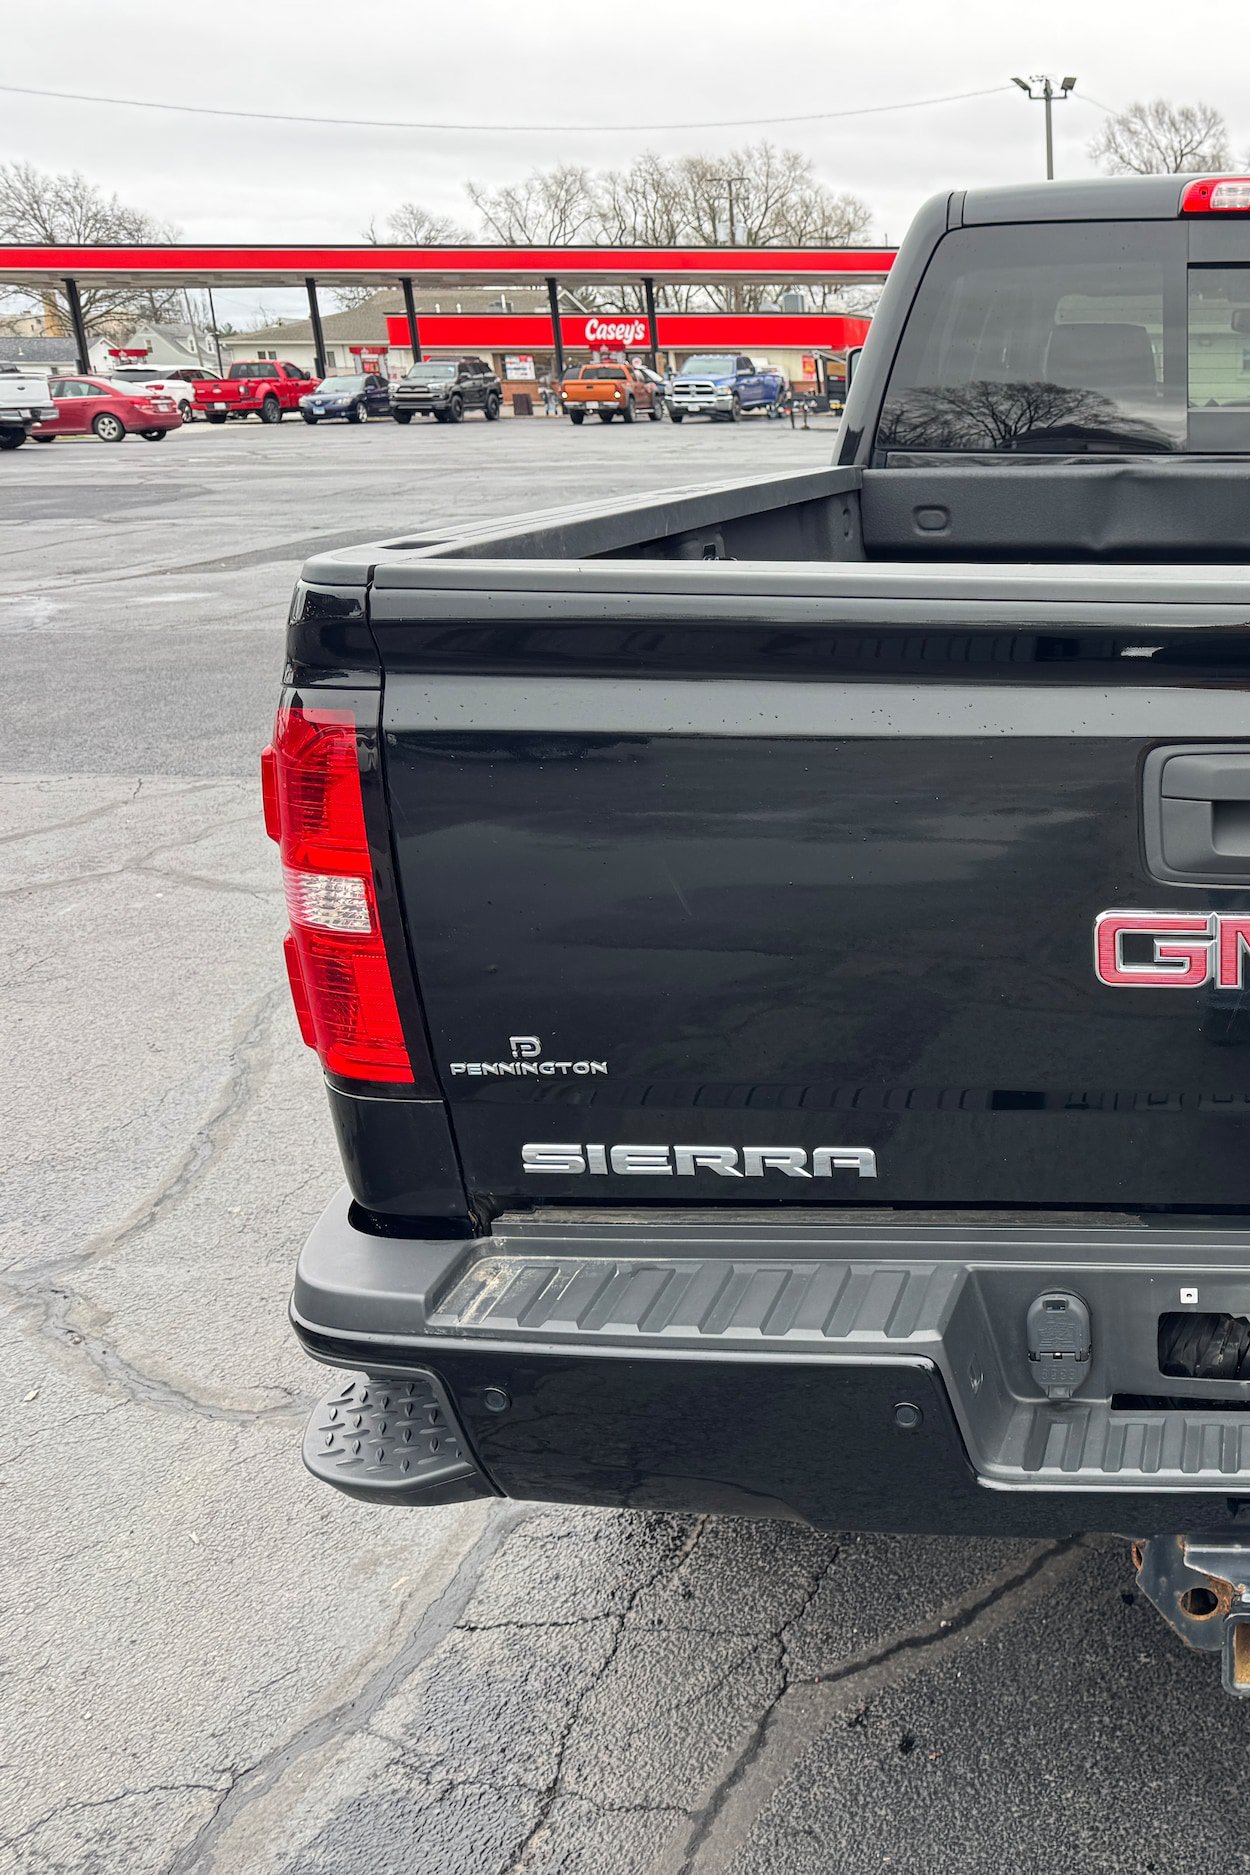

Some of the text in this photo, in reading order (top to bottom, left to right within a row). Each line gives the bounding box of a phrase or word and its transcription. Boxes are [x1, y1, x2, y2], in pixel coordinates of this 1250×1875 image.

[585, 318, 645, 345] Casey's
[449, 1060, 609, 1076] PENNINGTON
[522, 1144, 877, 1178] SIERRA
